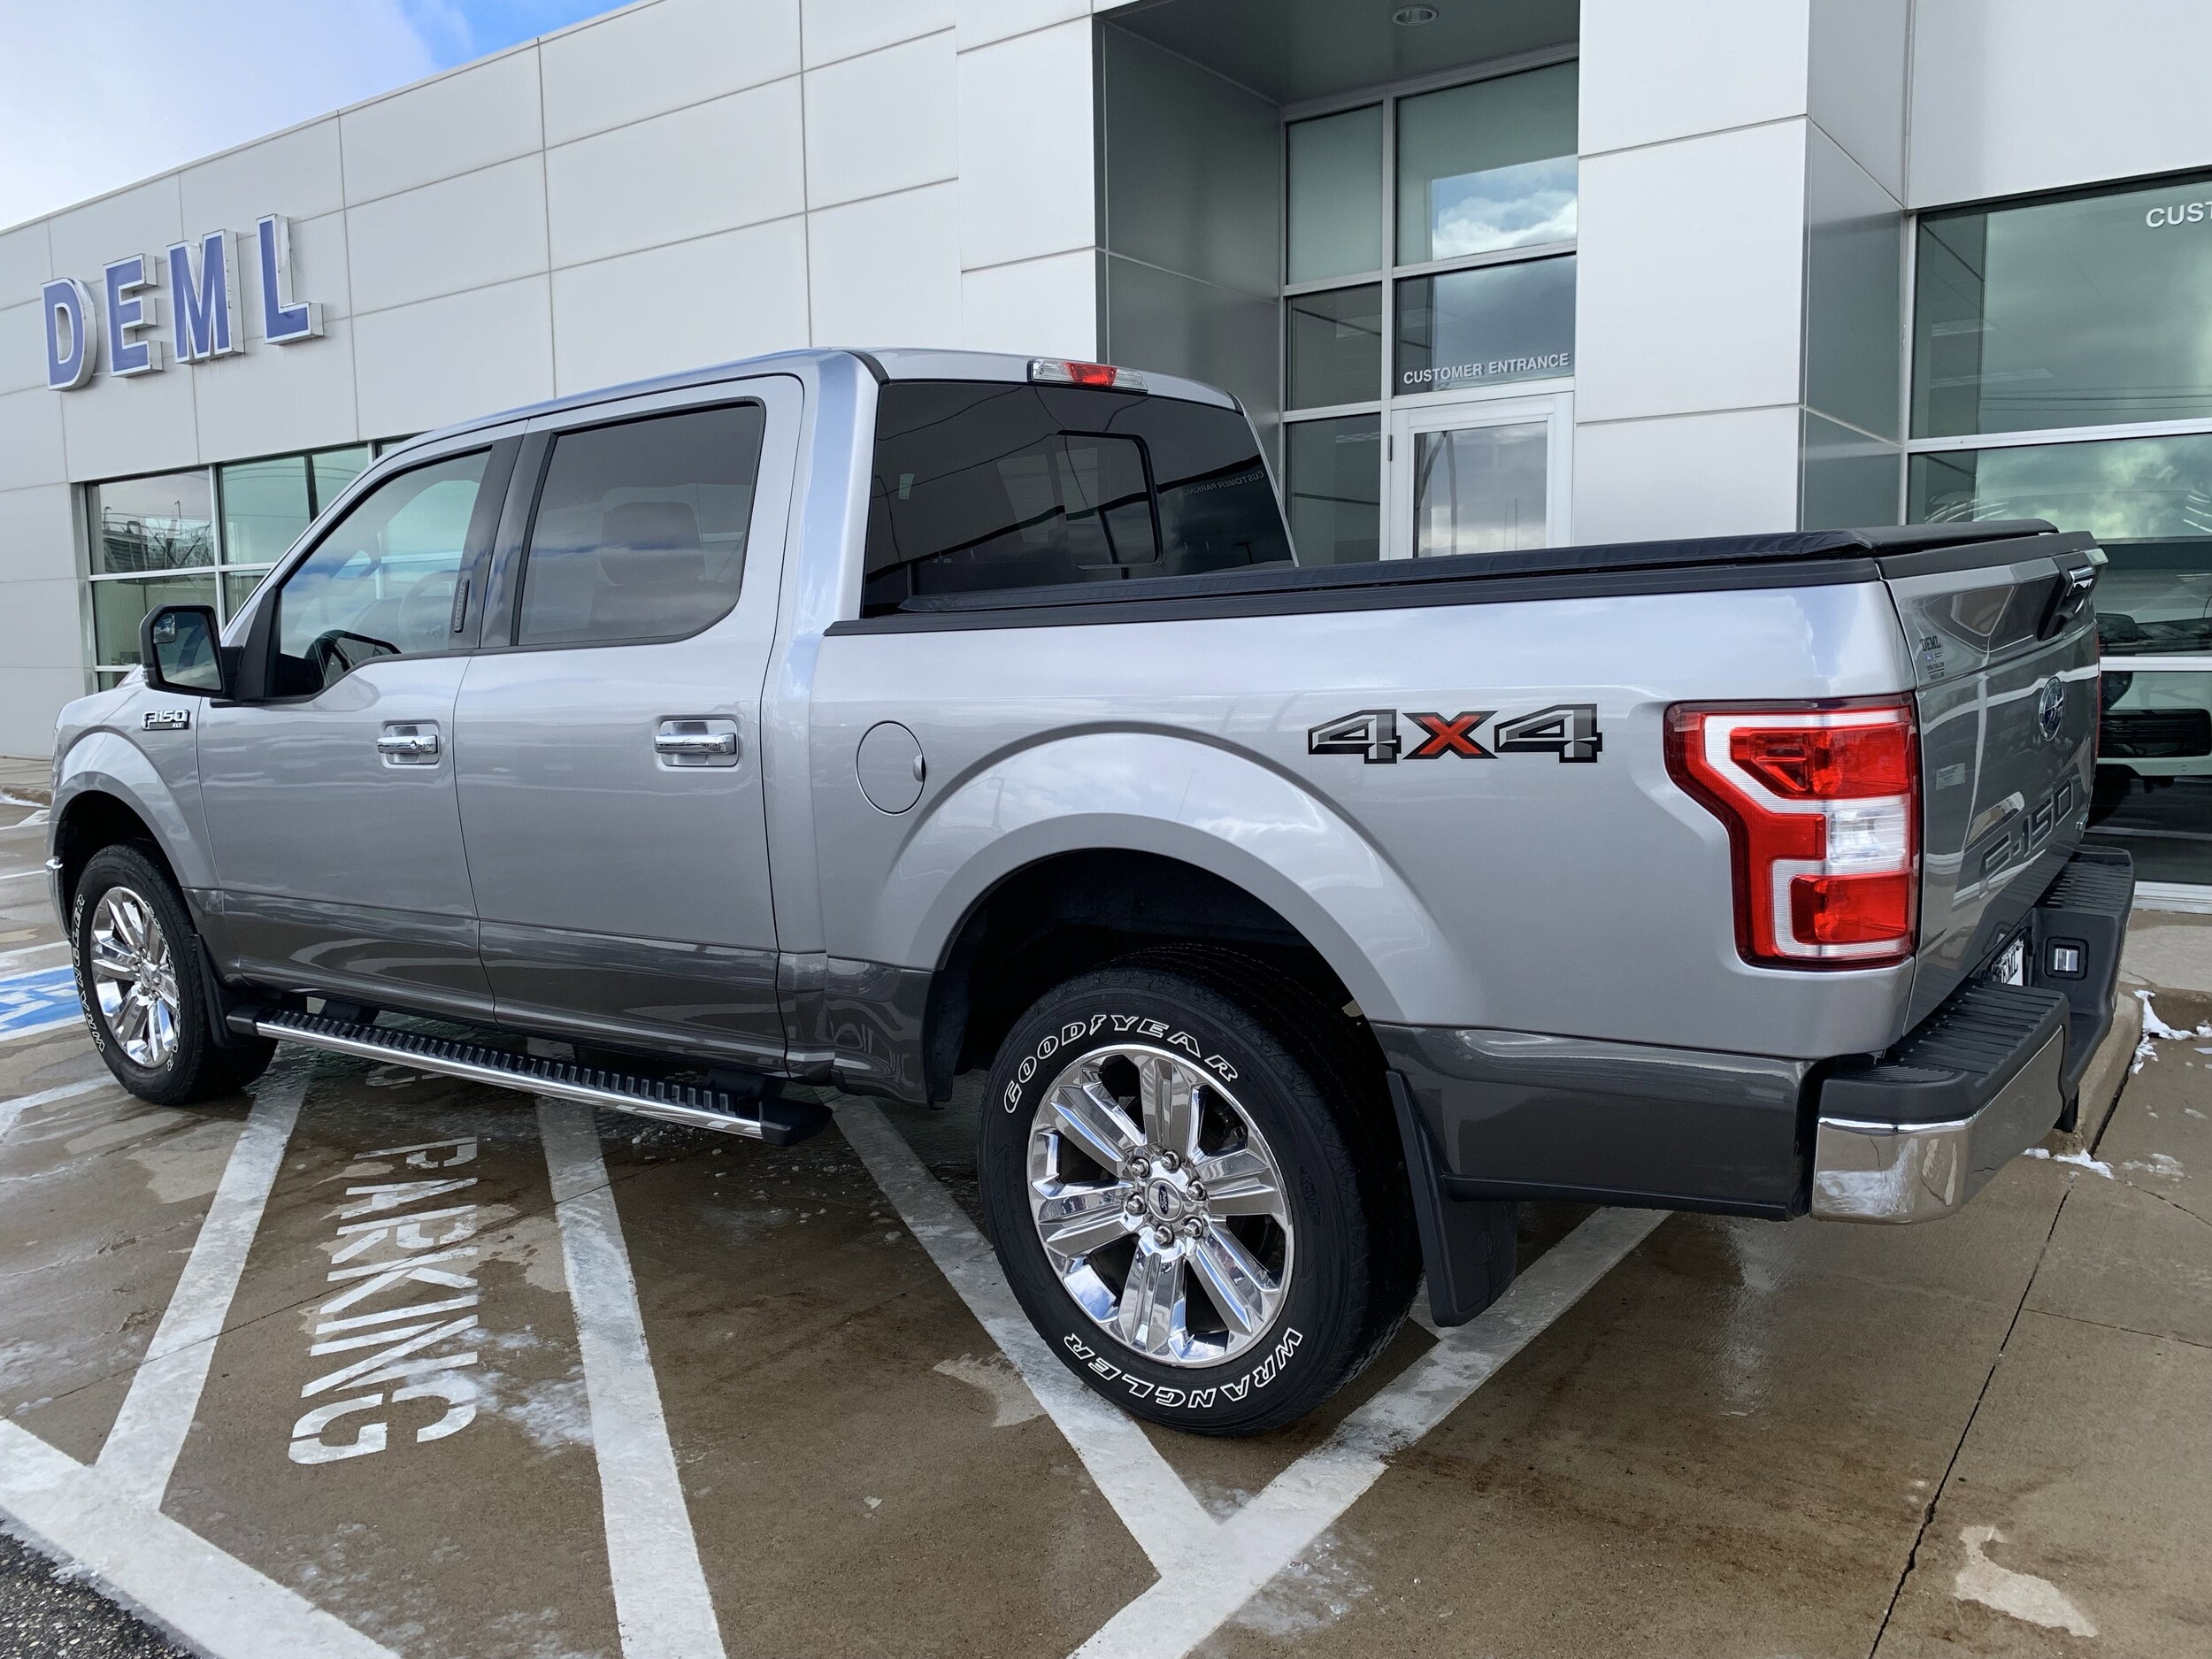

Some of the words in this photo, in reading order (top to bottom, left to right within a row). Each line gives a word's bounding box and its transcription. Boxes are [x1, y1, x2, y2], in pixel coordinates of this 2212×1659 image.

[41, 213, 324, 391] DEML
[1403, 364, 1484, 385] CUSTOMER
[1488, 352, 1570, 375] ENTRANCE
[1003, 1014, 1238, 1114] GOODYEAR
[288, 1136, 478, 1465] PARKING
[1064, 1328, 1303, 1409] WRANGLER
